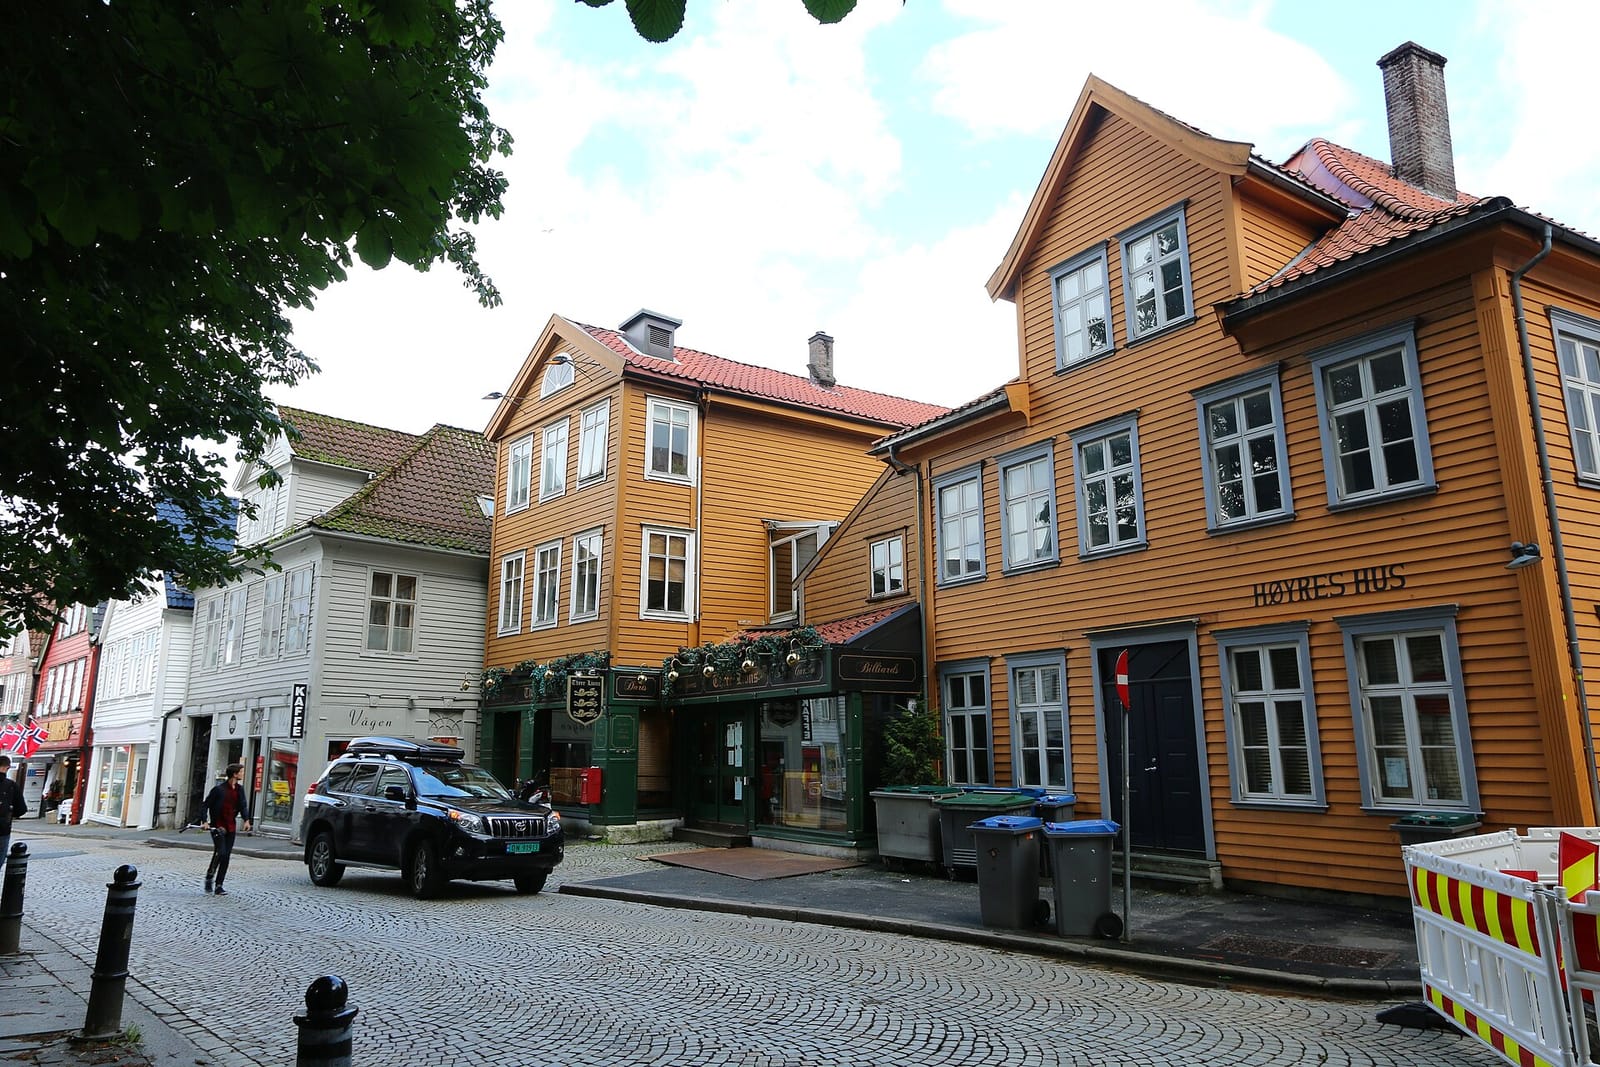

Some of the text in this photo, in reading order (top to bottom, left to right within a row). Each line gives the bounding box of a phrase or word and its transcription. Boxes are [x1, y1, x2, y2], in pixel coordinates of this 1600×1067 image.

[1253, 565, 1406, 607] HØYRES HUS
[860, 662, 899, 674] Billiards
[292, 686, 306, 737] KAFFE
[348, 709, 392, 730] Vågen
